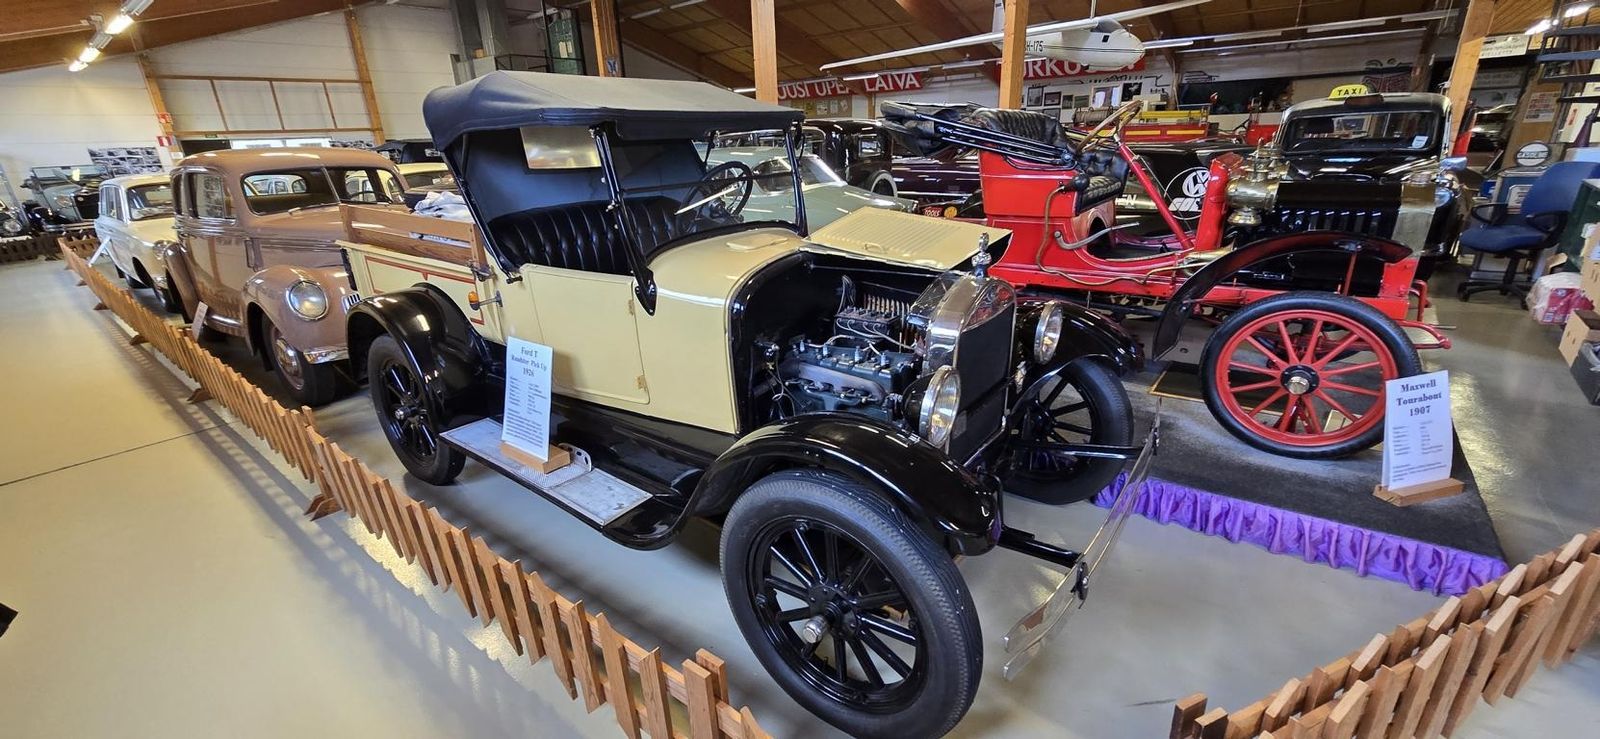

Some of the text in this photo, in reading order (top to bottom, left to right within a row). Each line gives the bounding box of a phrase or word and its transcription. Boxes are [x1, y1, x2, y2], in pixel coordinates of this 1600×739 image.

[1024, 40, 1044, 52] H-175
[865, 73, 921, 92] LAIVA
[1337, 88, 1362, 96] TAXI
[521, 346, 533, 357] Ford
[1400, 379, 1437, 393] Maxwell
[1396, 392, 1442, 406] Tourabout
[1410, 406, 1431, 416] 1907
